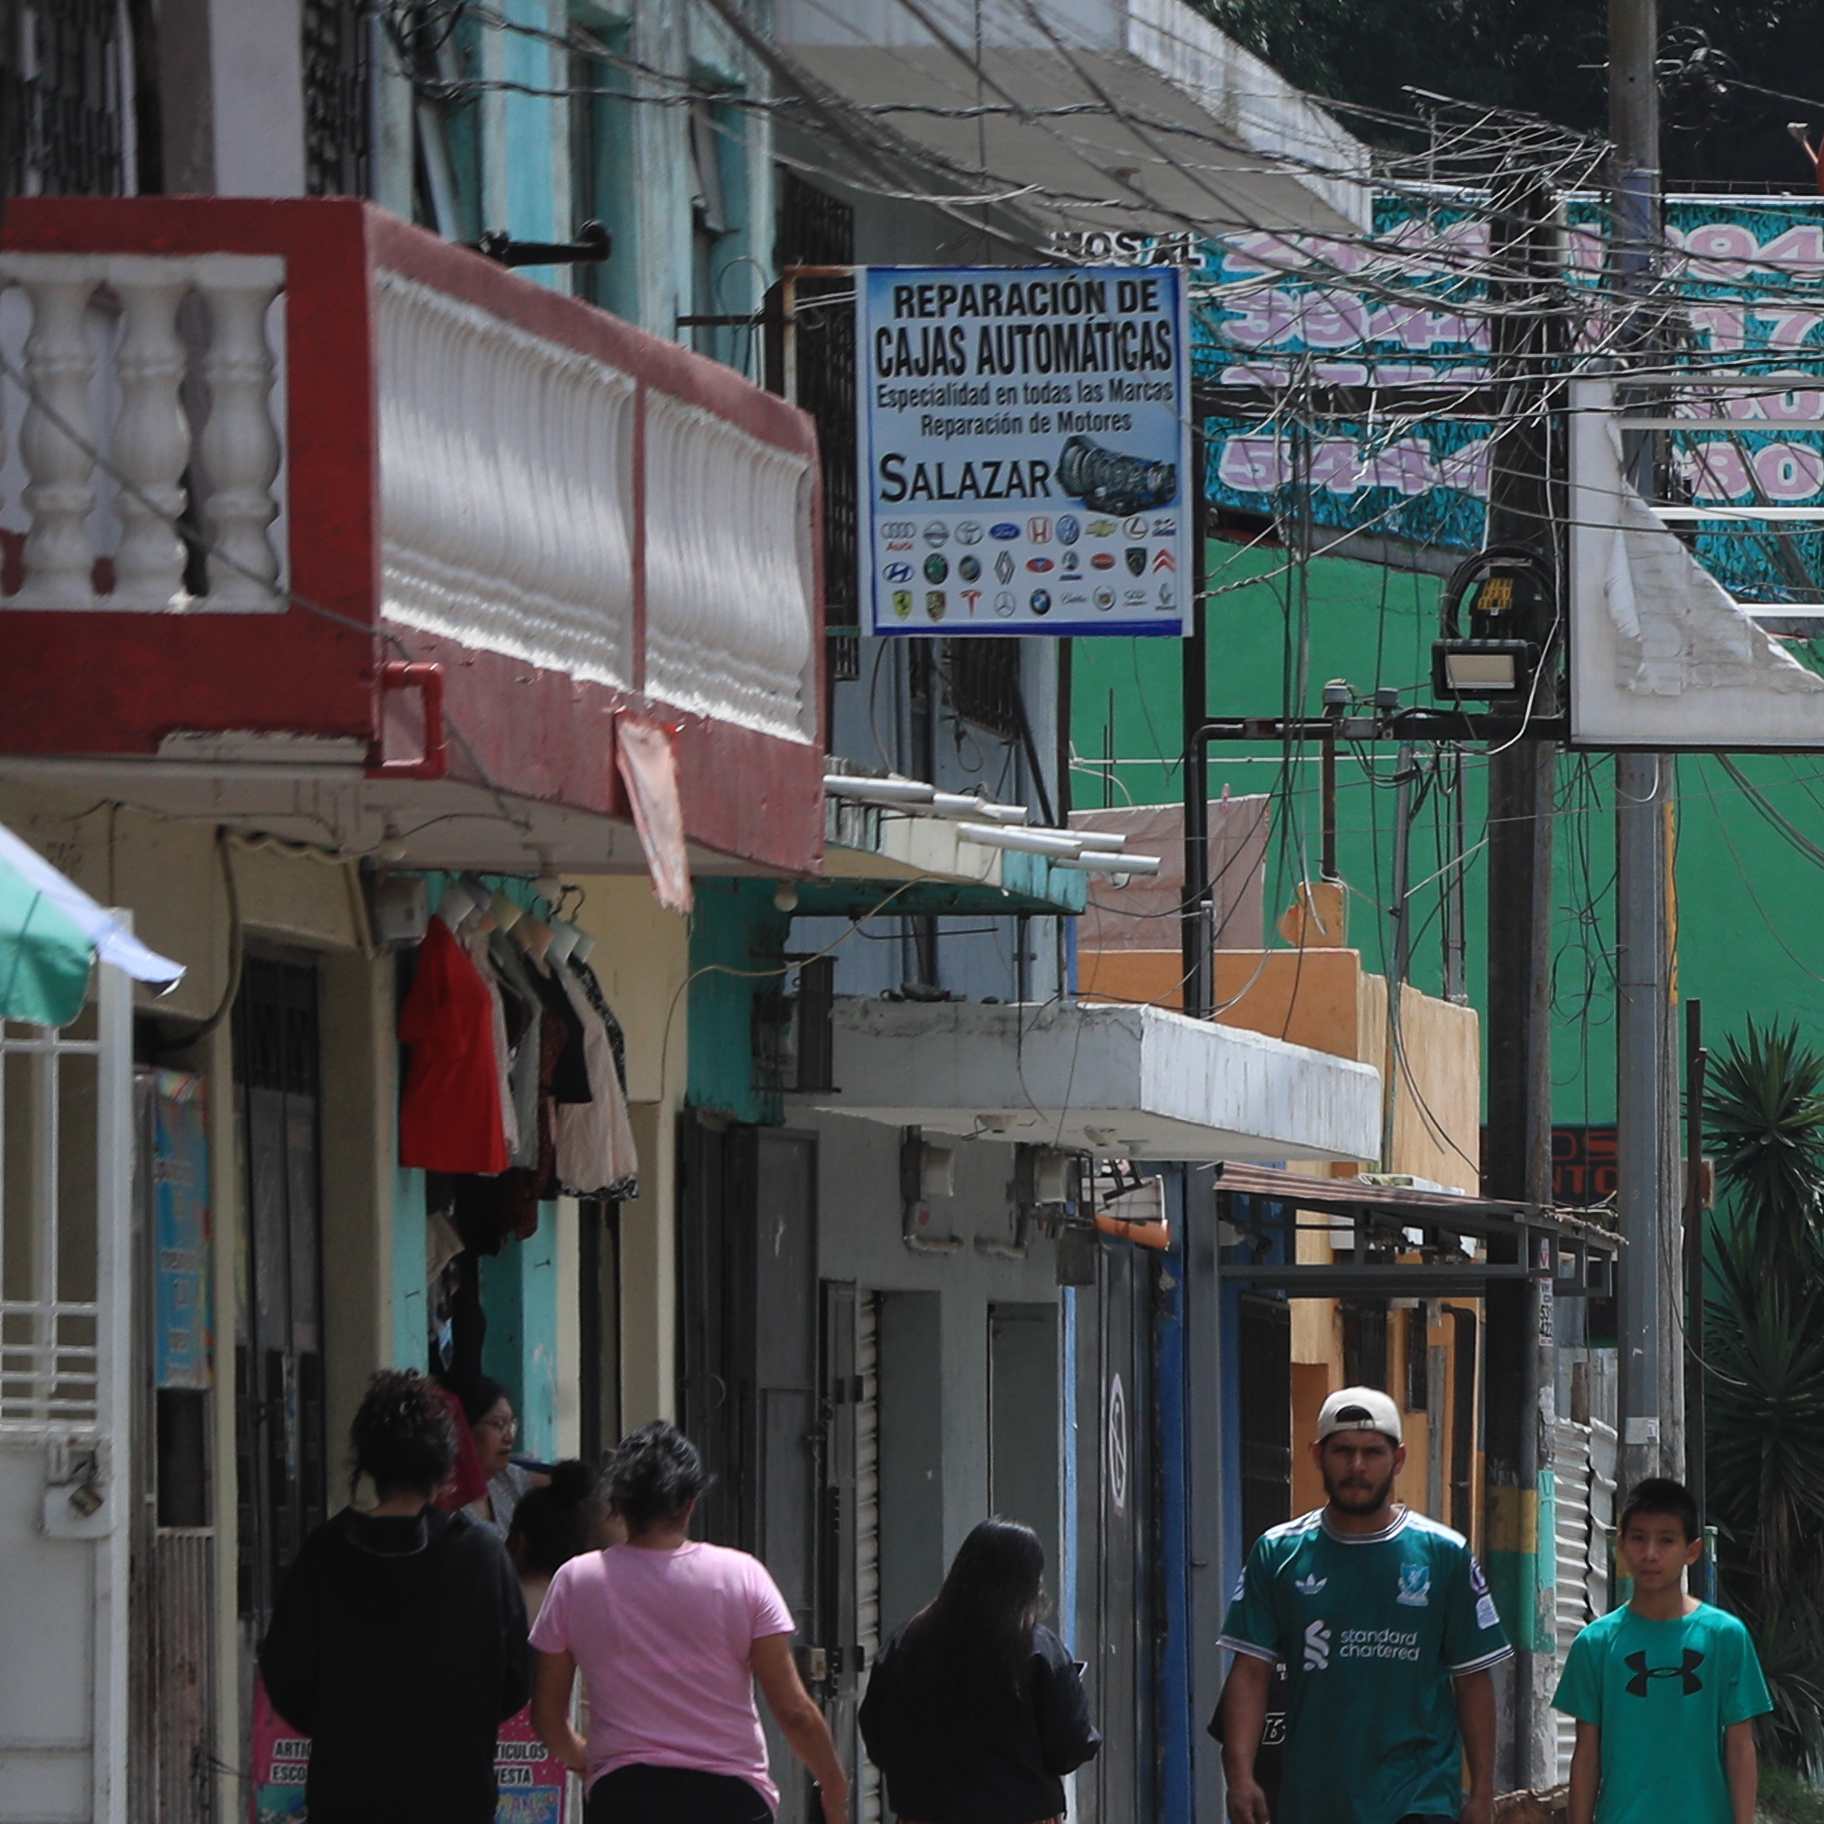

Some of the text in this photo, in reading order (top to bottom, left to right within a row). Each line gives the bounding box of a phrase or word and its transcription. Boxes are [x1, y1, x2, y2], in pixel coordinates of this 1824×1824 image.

[893, 274, 1159, 319] REPARACIÓN DE
[875, 324, 967, 378] CAJAS
[976, 316, 1173, 376] AUTOMÁTICAS
[877, 377, 1174, 412] Especialidad en todas las Marcas
[921, 410, 1133, 440] Reparación de Motores
[879, 452, 1053, 503] SALAZAR
[1340, 1628, 1418, 1645] standard
[1339, 1643, 1421, 1661] chartered
[496, 1742, 547, 1759] TICULOS
[496, 1768, 531, 1784] ESTA
